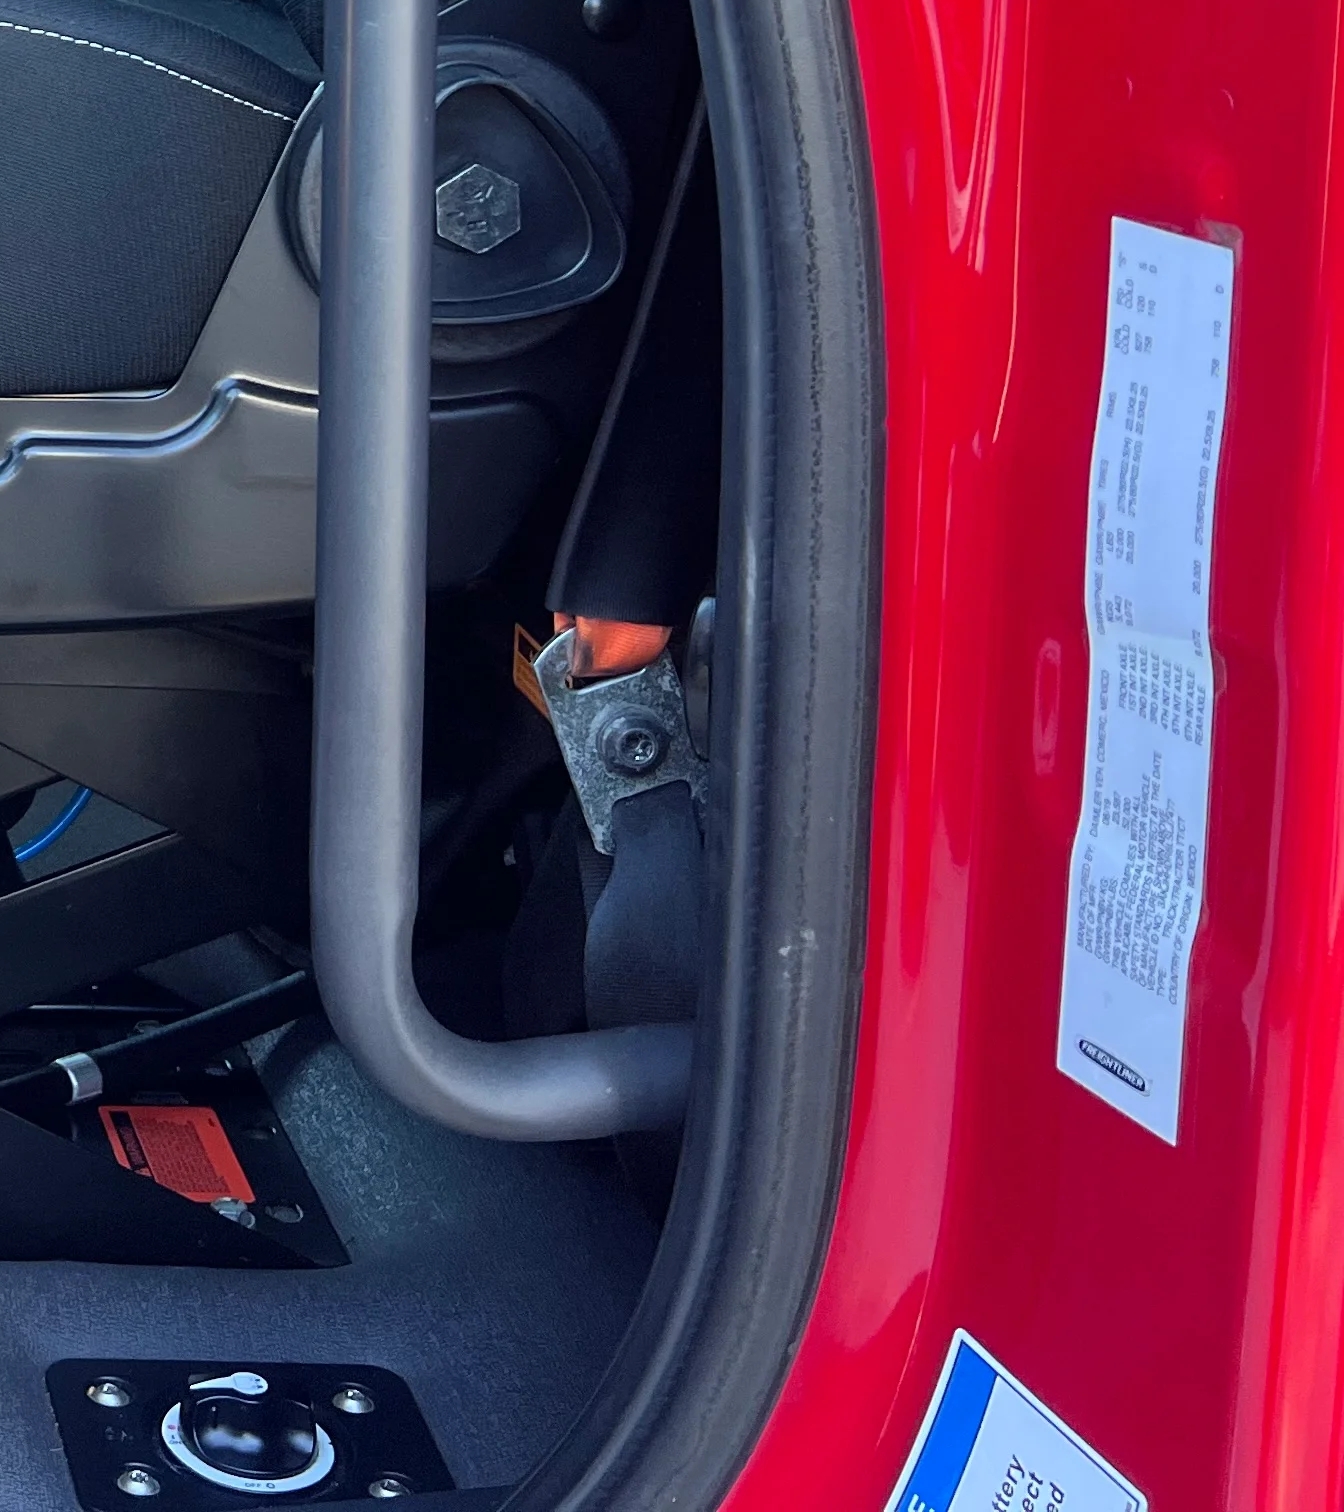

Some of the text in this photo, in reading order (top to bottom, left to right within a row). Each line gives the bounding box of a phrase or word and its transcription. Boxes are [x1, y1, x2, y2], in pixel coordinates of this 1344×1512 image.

[1100, 669, 1109, 711] MEXICO
[1118, 669, 1128, 709] FRONT
[1194, 715, 1204, 747] REAR
[1136, 820, 1146, 861] MOTOR
[1141, 774, 1151, 818] VEHICLE
[1168, 953, 1180, 1005] COUNTRY
[1186, 844, 1197, 889] MEXICO
[1081, 1040, 1145, 1089] FREIGHTLINER
[992, 1454, 1025, 1512] ttery
